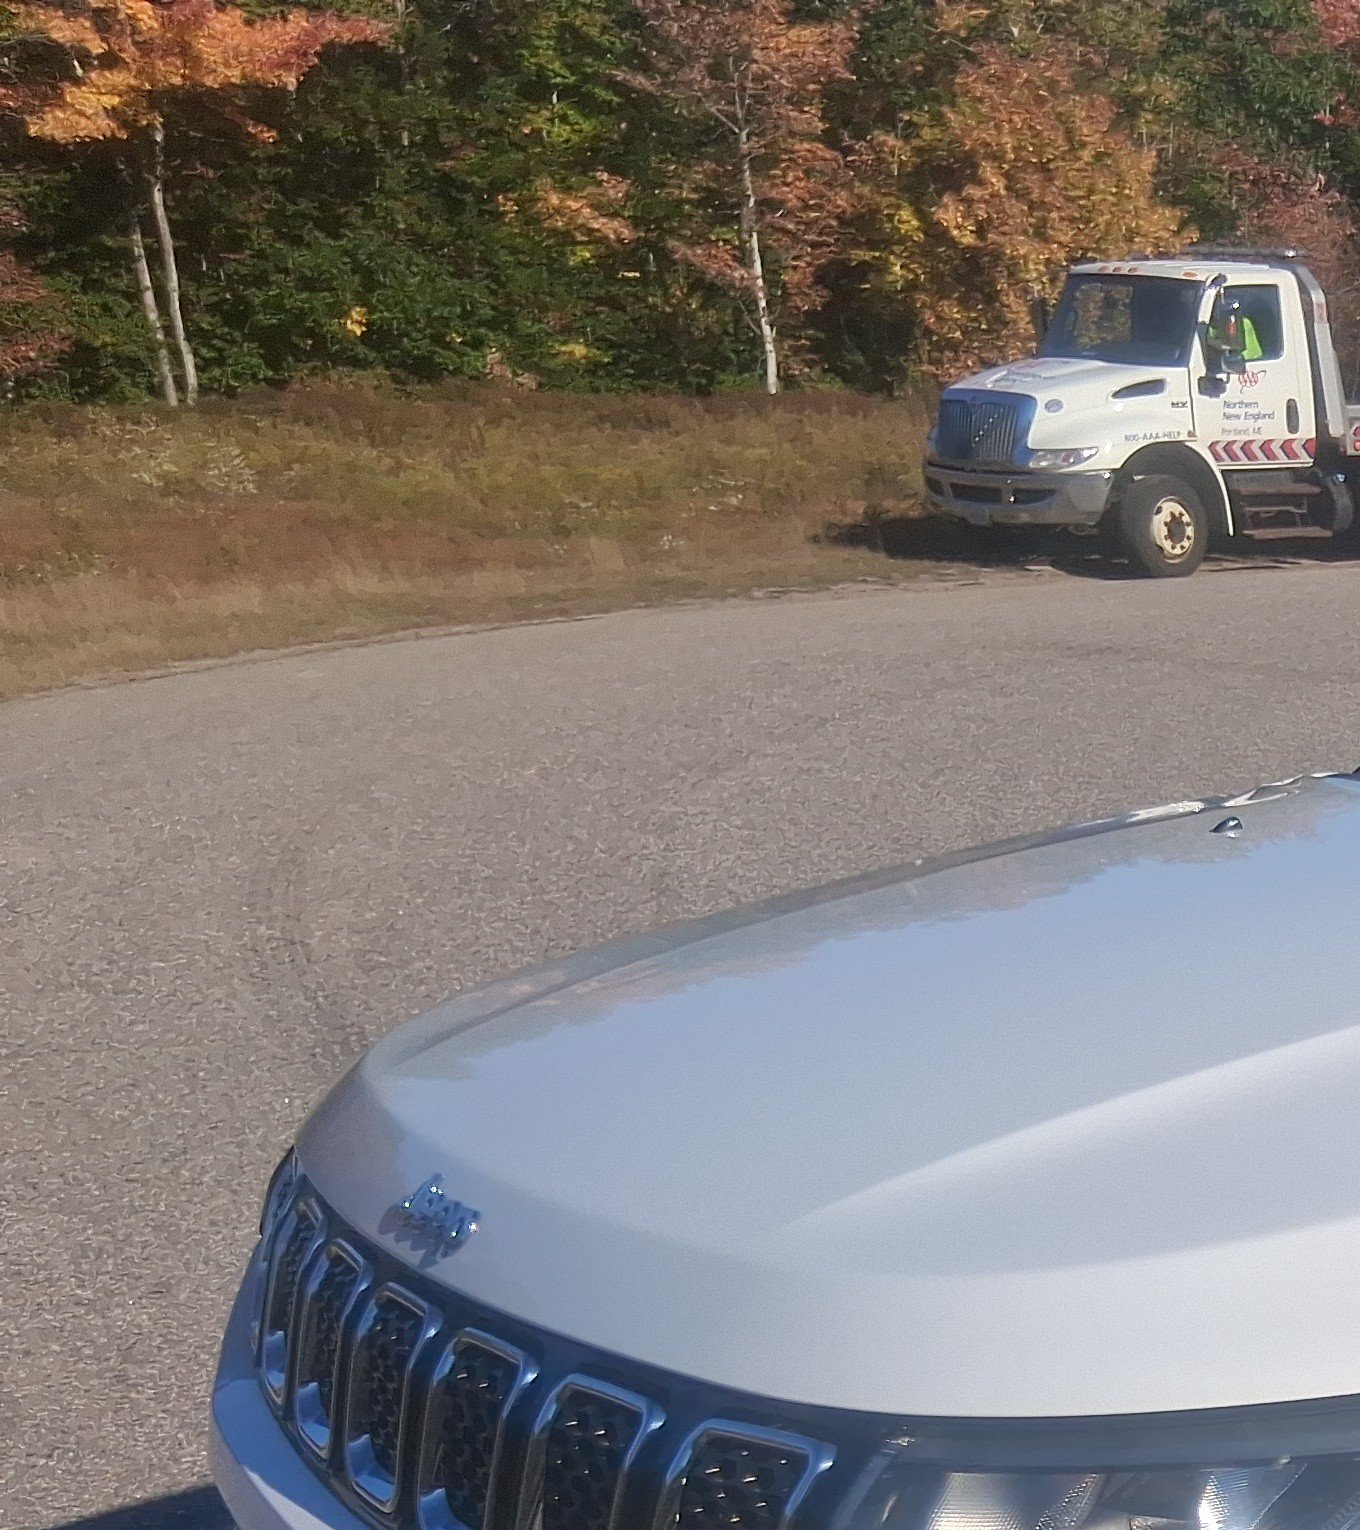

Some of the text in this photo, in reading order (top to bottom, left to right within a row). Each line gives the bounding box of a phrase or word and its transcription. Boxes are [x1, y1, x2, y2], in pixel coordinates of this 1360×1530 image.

[1223, 400, 1259, 409] Northern
[1223, 411, 1275, 423] New England
